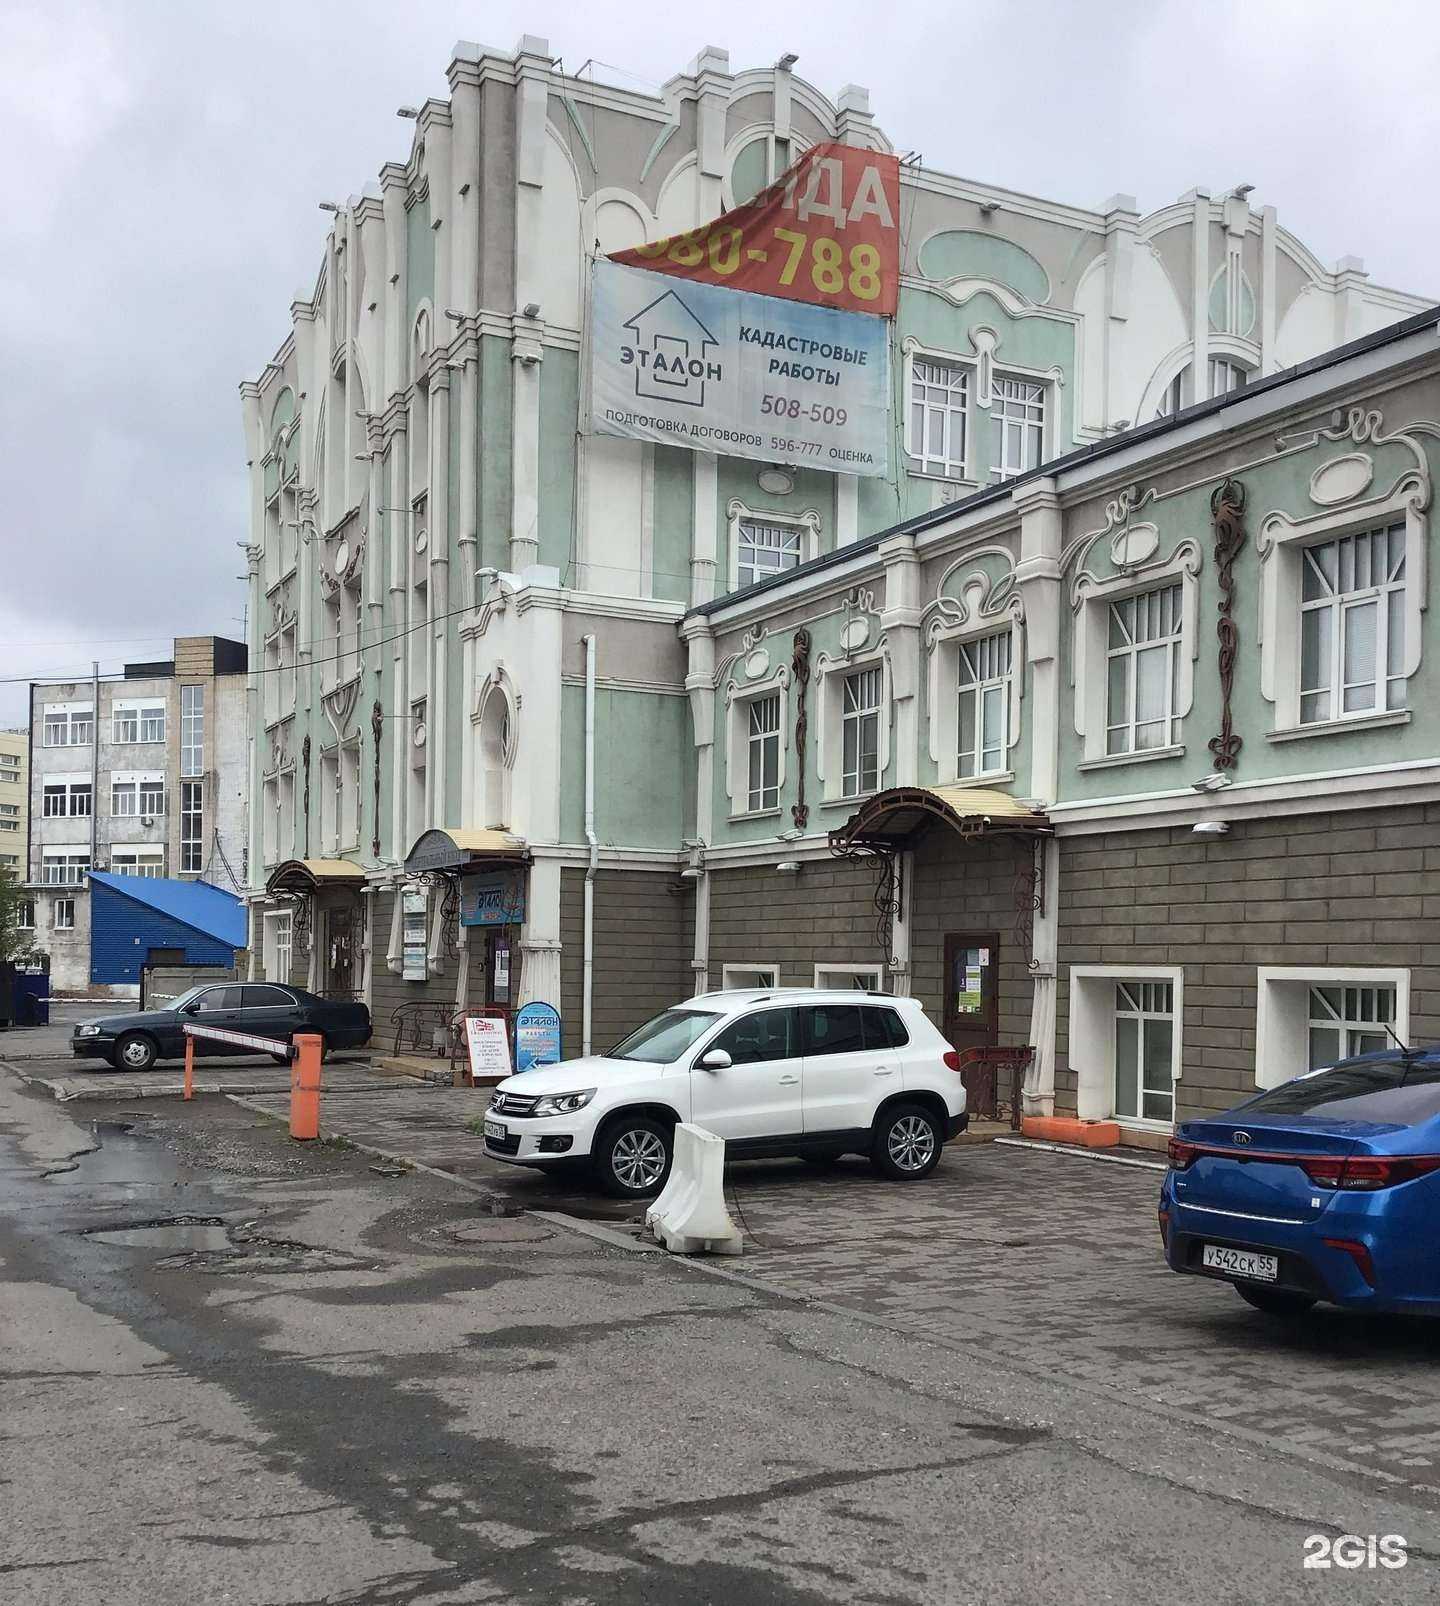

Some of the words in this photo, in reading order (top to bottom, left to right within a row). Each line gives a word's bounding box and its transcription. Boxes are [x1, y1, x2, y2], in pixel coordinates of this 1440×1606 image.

[634, 225, 882, 301] 80-788
[739, 326, 868, 366] КАДАСТРОВЫЕ
[620, 346, 722, 382] ЭТАЛОН
[769, 358, 841, 387] РАБОТЫ
[760, 394, 848, 426] 508-509
[606, 409, 688, 434] ПОДГОТОВКА
[690, 424, 762, 447] ДОГОВОРОВ
[771, 436, 823, 457] 596-777
[829, 447, 874, 465] ОЦЕНКА
[1234, 1134, 1248, 1144] KIA
[1207, 1248, 1255, 1273] У542СК
[1259, 1255, 1274, 1272] 55
